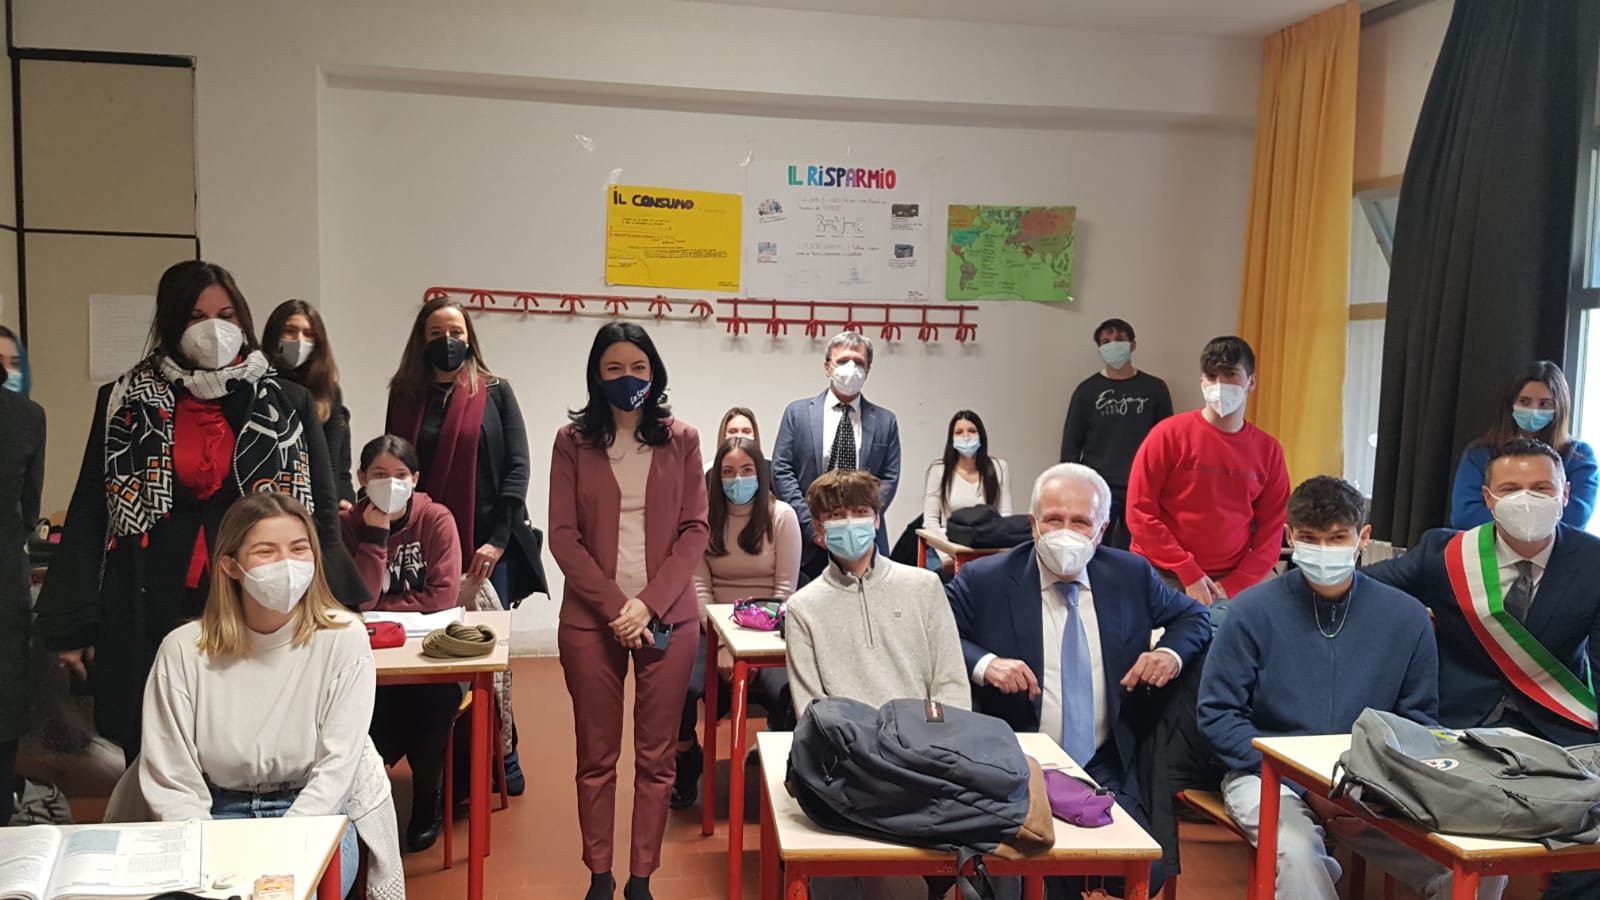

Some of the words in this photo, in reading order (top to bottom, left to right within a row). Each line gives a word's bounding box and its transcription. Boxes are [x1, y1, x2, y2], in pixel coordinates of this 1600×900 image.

[788, 165, 804, 186] IL
[631, 194, 695, 210] CONSUMO
[1095, 388, 1150, 417] Enjoy
